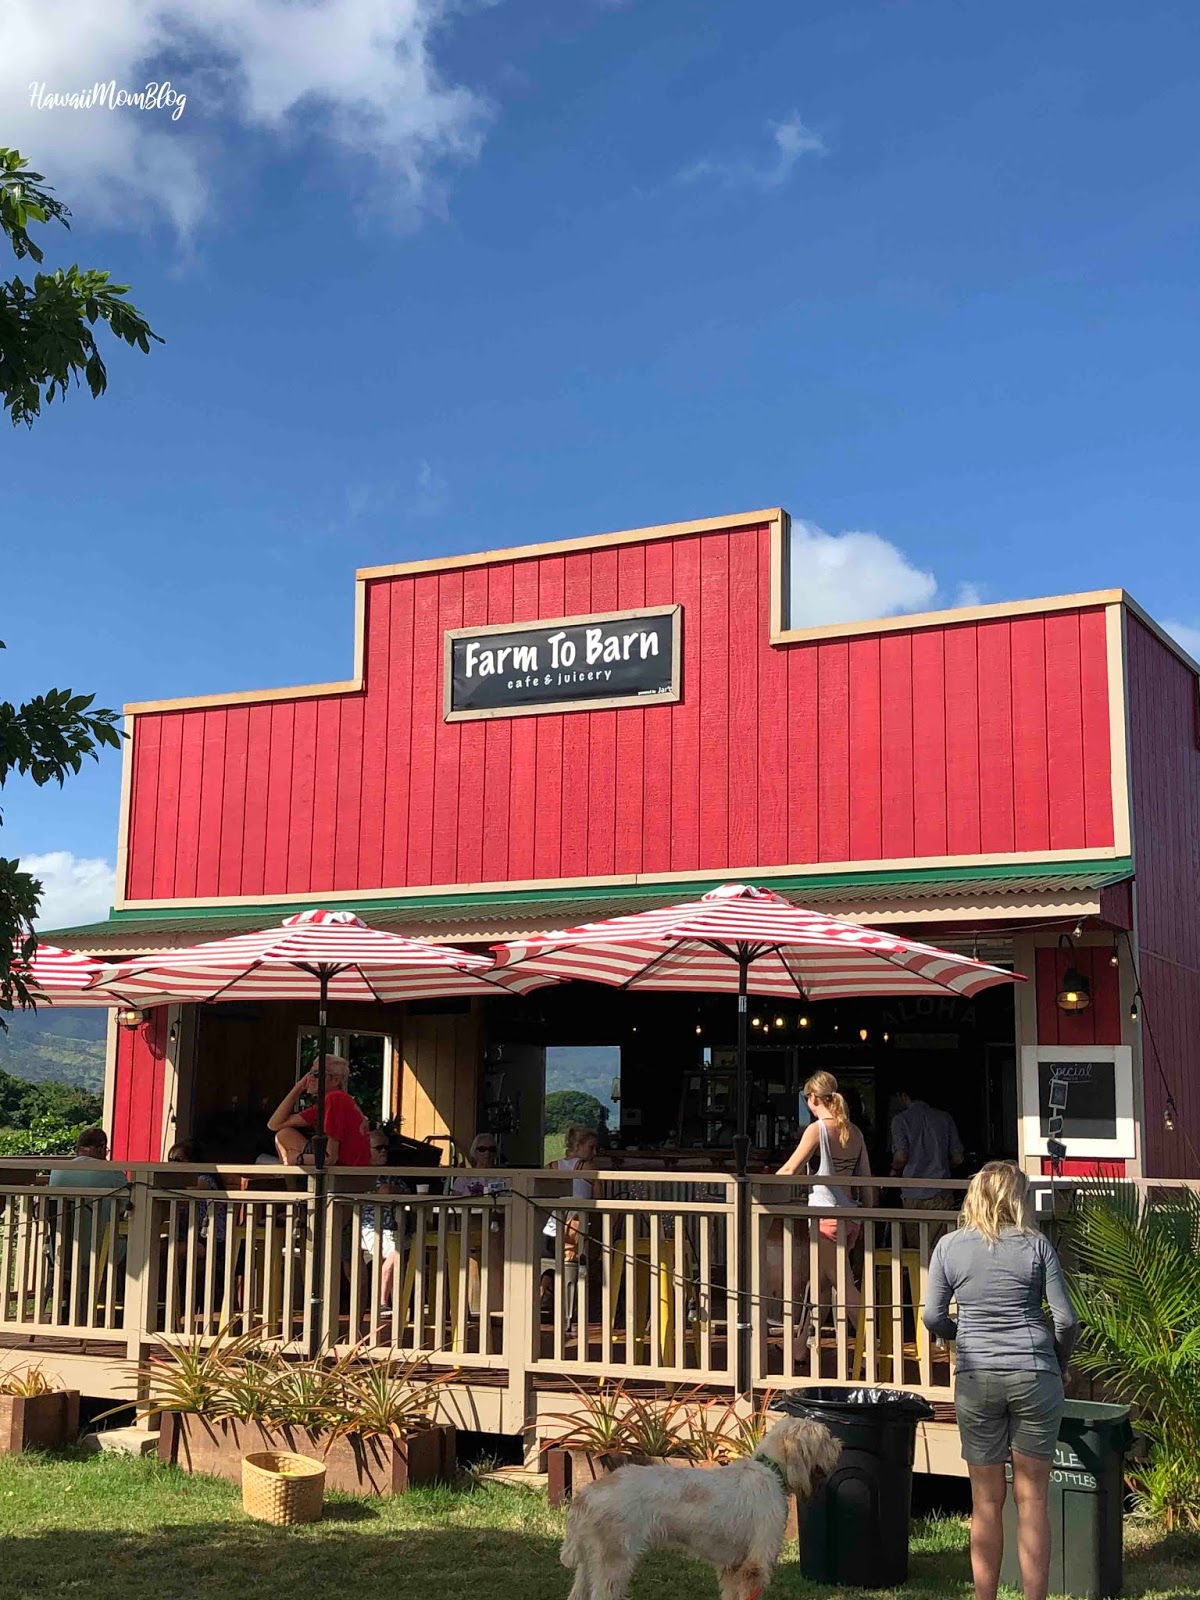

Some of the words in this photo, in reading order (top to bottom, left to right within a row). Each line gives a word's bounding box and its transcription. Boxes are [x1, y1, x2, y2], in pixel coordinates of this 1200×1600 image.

[465, 642, 538, 678] Farm
[547, 631, 576, 669] To
[585, 628, 659, 665] Barn
[507, 676, 539, 689] cafe
[544, 674, 553, 685] &
[557, 669, 612, 686] juicery
[881, 997, 976, 1028] ALOHA
